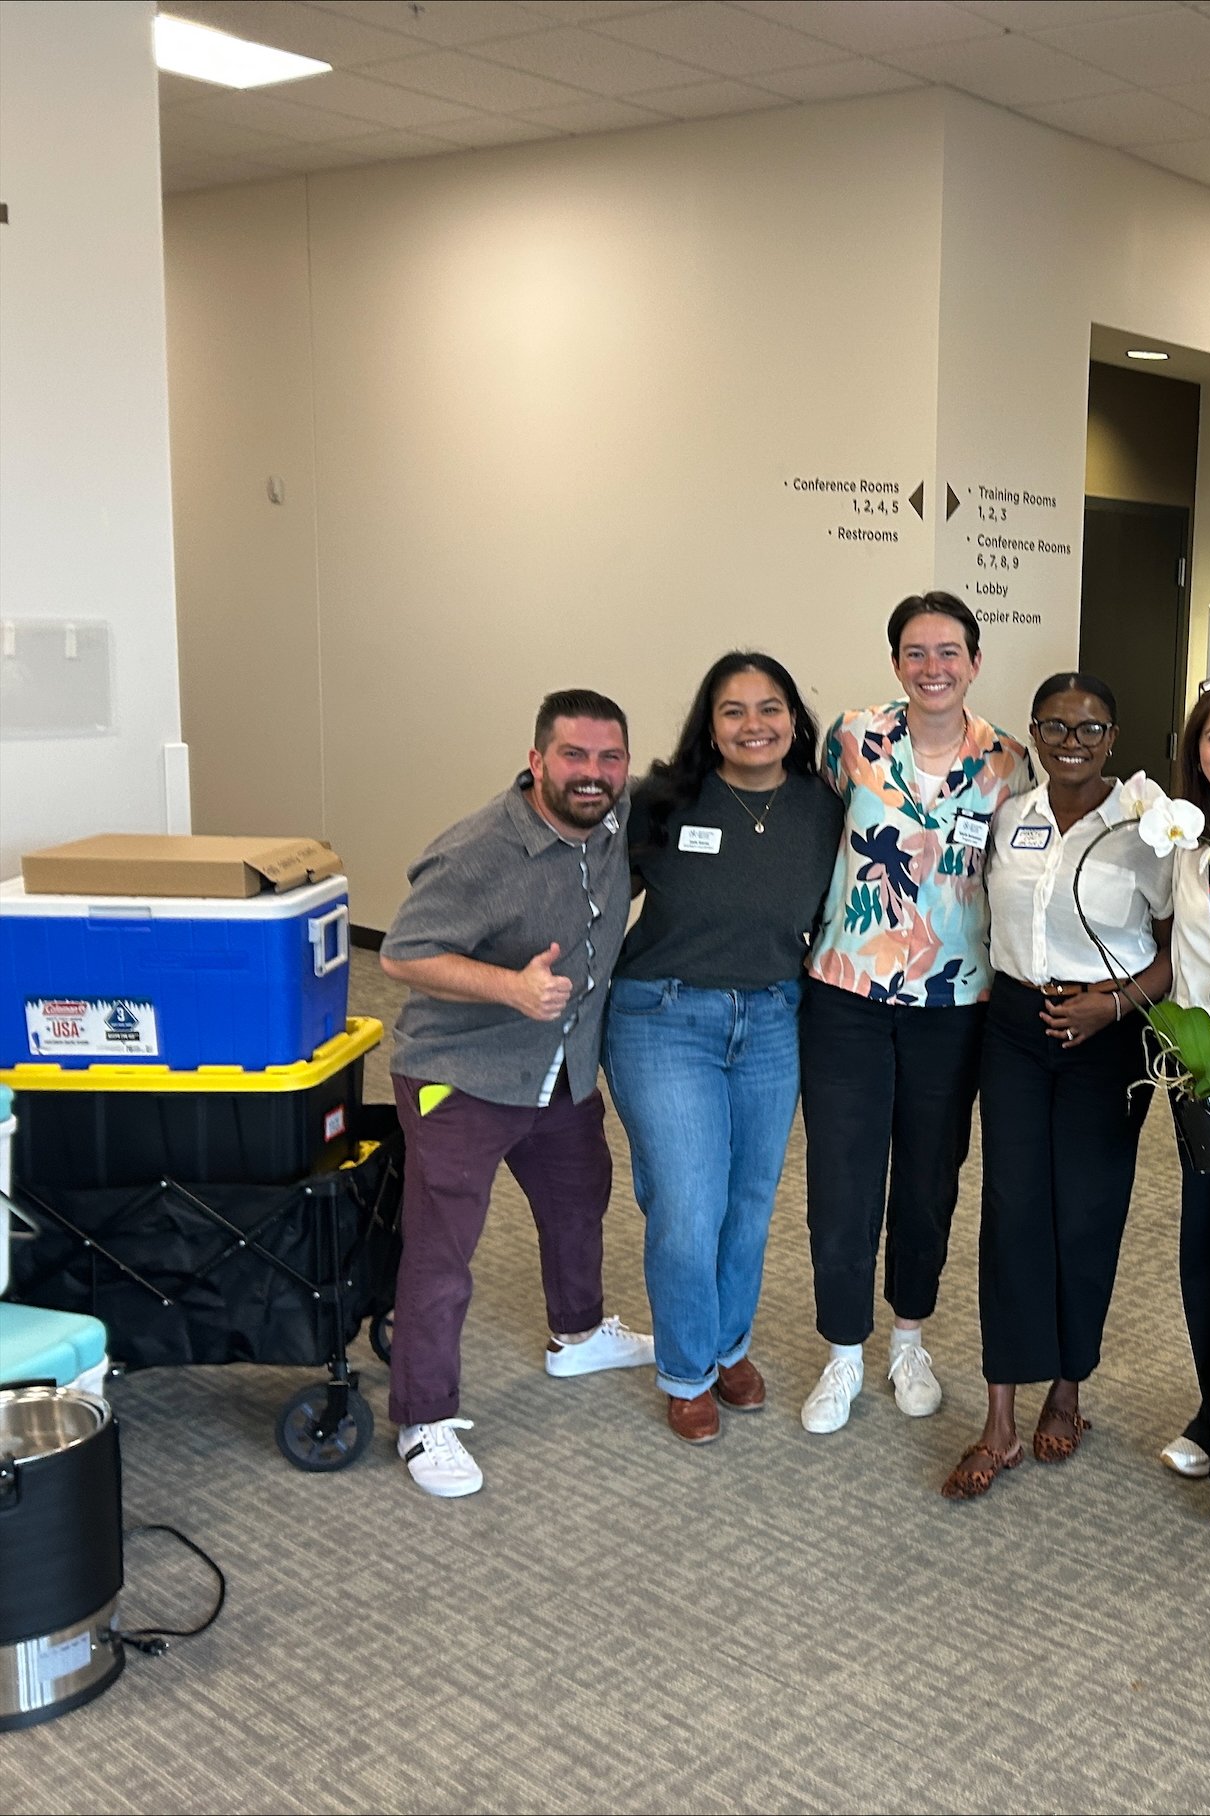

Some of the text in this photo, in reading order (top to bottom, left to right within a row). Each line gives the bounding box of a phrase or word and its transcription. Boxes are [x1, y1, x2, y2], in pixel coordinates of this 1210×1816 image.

[793, 477, 900, 494] Conference Rooms
[978, 485, 1057, 508] Training Rooms
[852, 499, 899, 516] 1, 2, 4, 5
[978, 505, 1007, 523] 1, 2, 3
[838, 526, 899, 543] Restrooms
[978, 533, 1072, 555] Conference Rooms
[977, 552, 1019, 571] 6, 7, 8, 9
[976, 581, 1008, 598] Lobby
[976, 608, 1042, 625] Copier Room
[52, 1021, 80, 1038] USA
